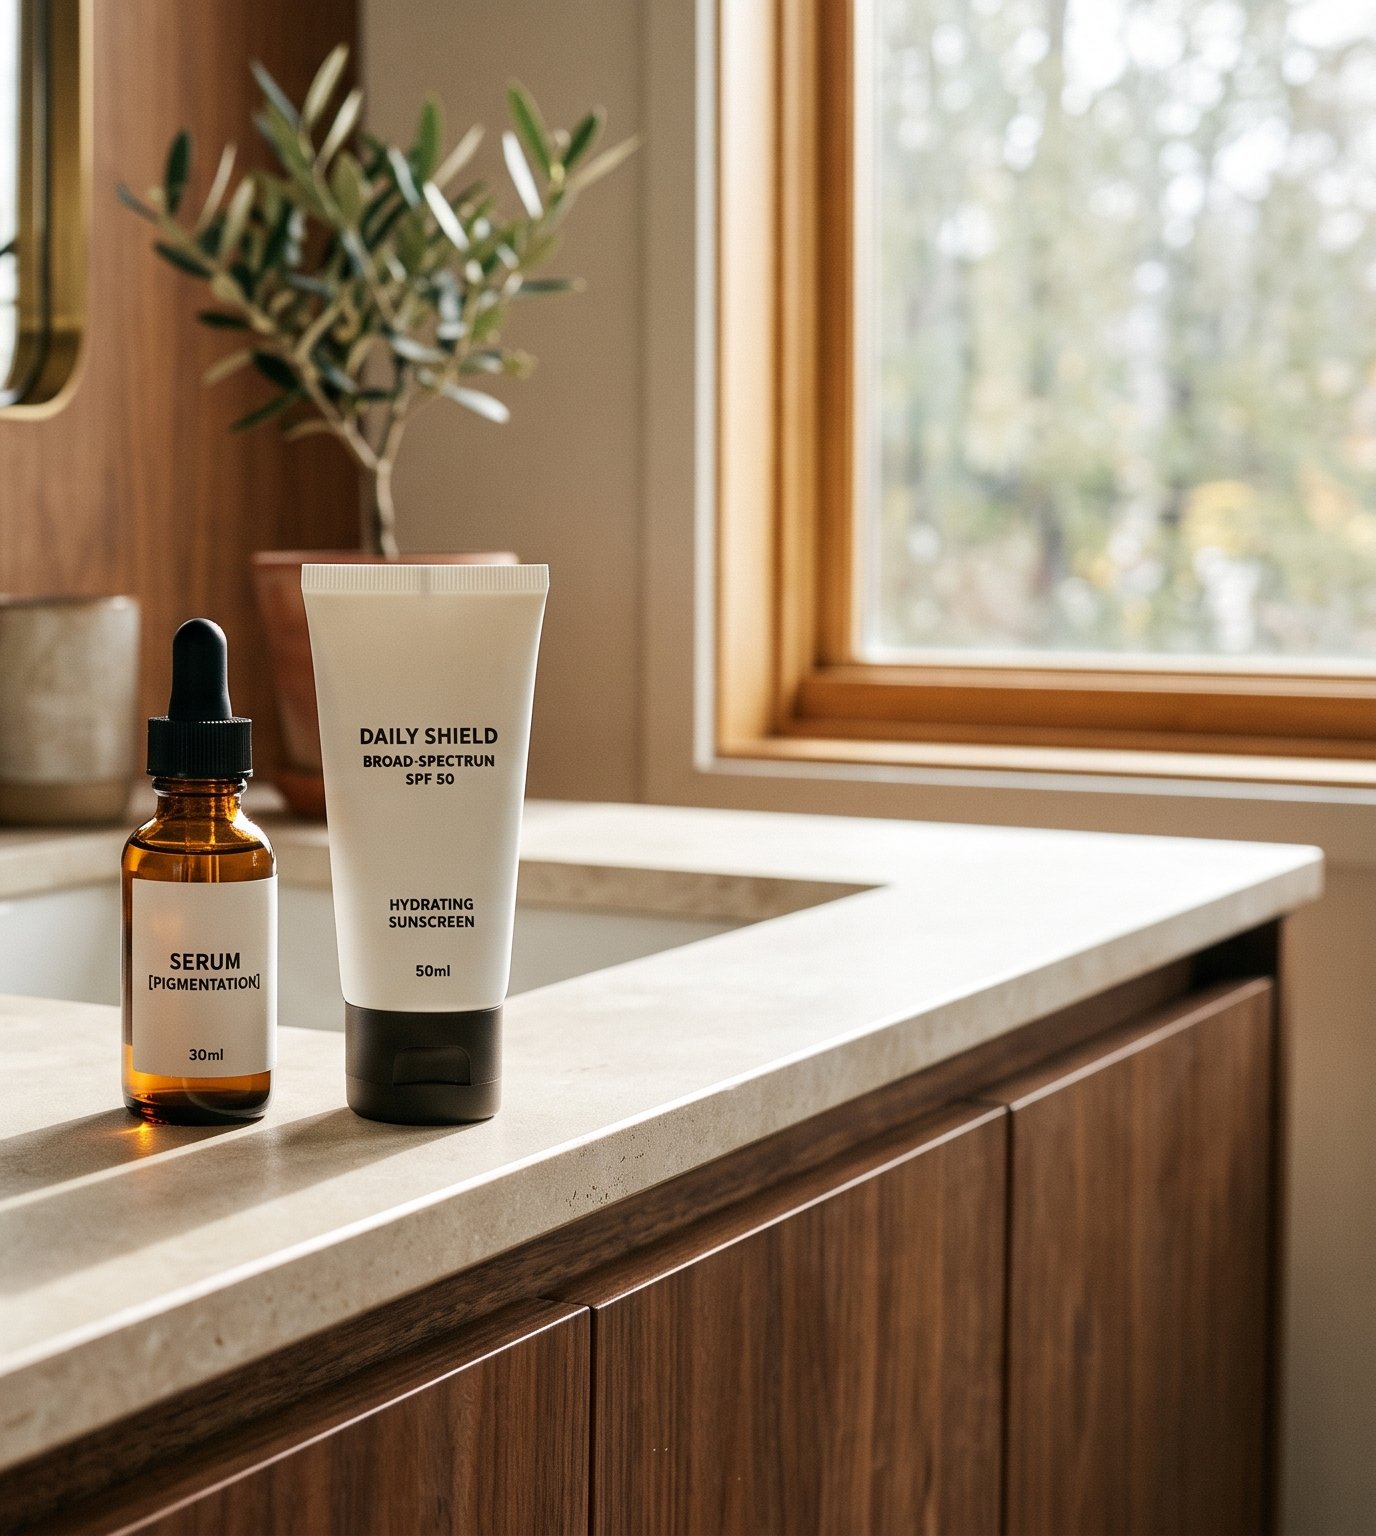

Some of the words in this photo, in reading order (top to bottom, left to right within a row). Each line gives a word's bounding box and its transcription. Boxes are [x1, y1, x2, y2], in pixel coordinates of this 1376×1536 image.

[359, 727, 420, 745] DAILY
[424, 727, 499, 745] SHIELD
[405, 772, 433, 786] SPF
[436, 772, 455, 786] 50
[389, 897, 474, 912] HYDRATING
[388, 915, 475, 929] SUNSCREEN
[169, 951, 241, 971] SERUM
[415, 964, 451, 978] 50ml
[148, 973, 261, 992] [PIGMENTATION]
[188, 1048, 224, 1062] 30ml
